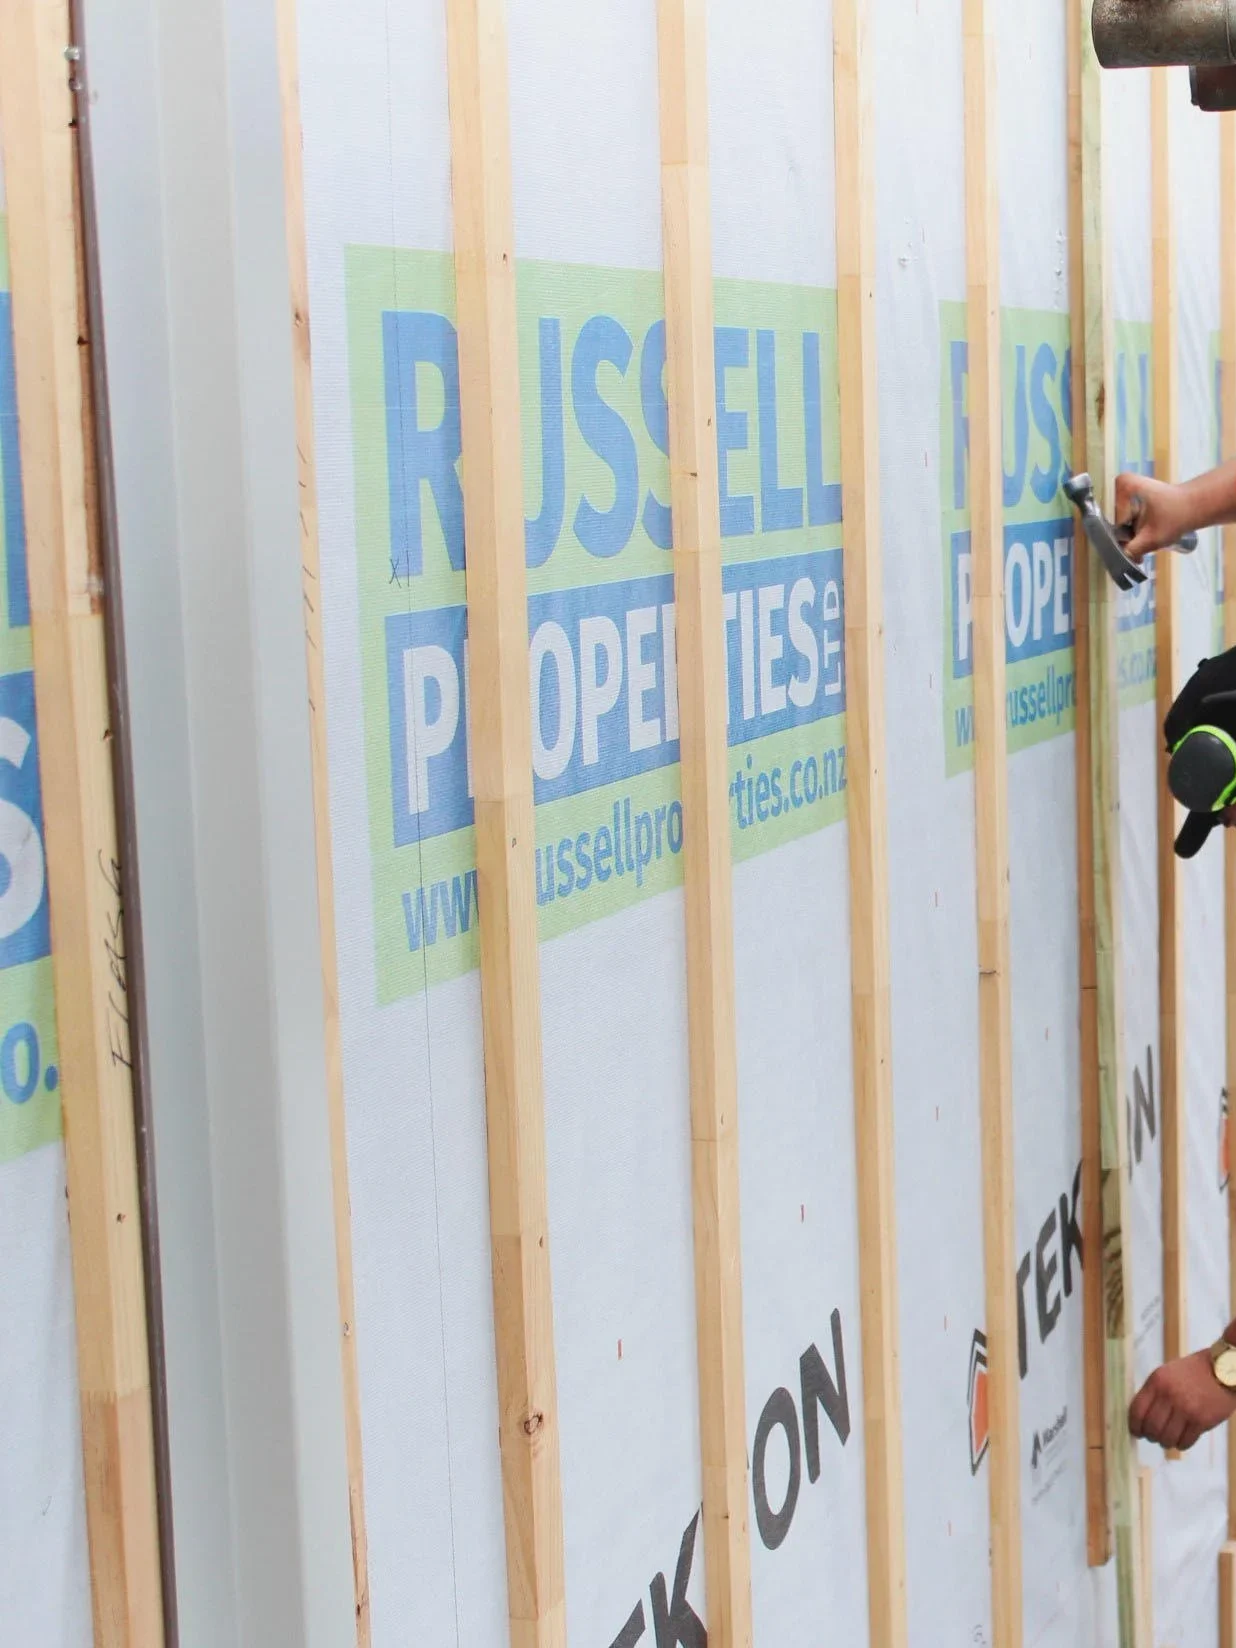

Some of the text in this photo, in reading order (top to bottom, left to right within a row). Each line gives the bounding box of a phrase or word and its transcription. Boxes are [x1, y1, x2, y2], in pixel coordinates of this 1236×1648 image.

[403, 578, 842, 815] POPEIES LTD
[402, 745, 847, 952] wwussellproties.co.nz
